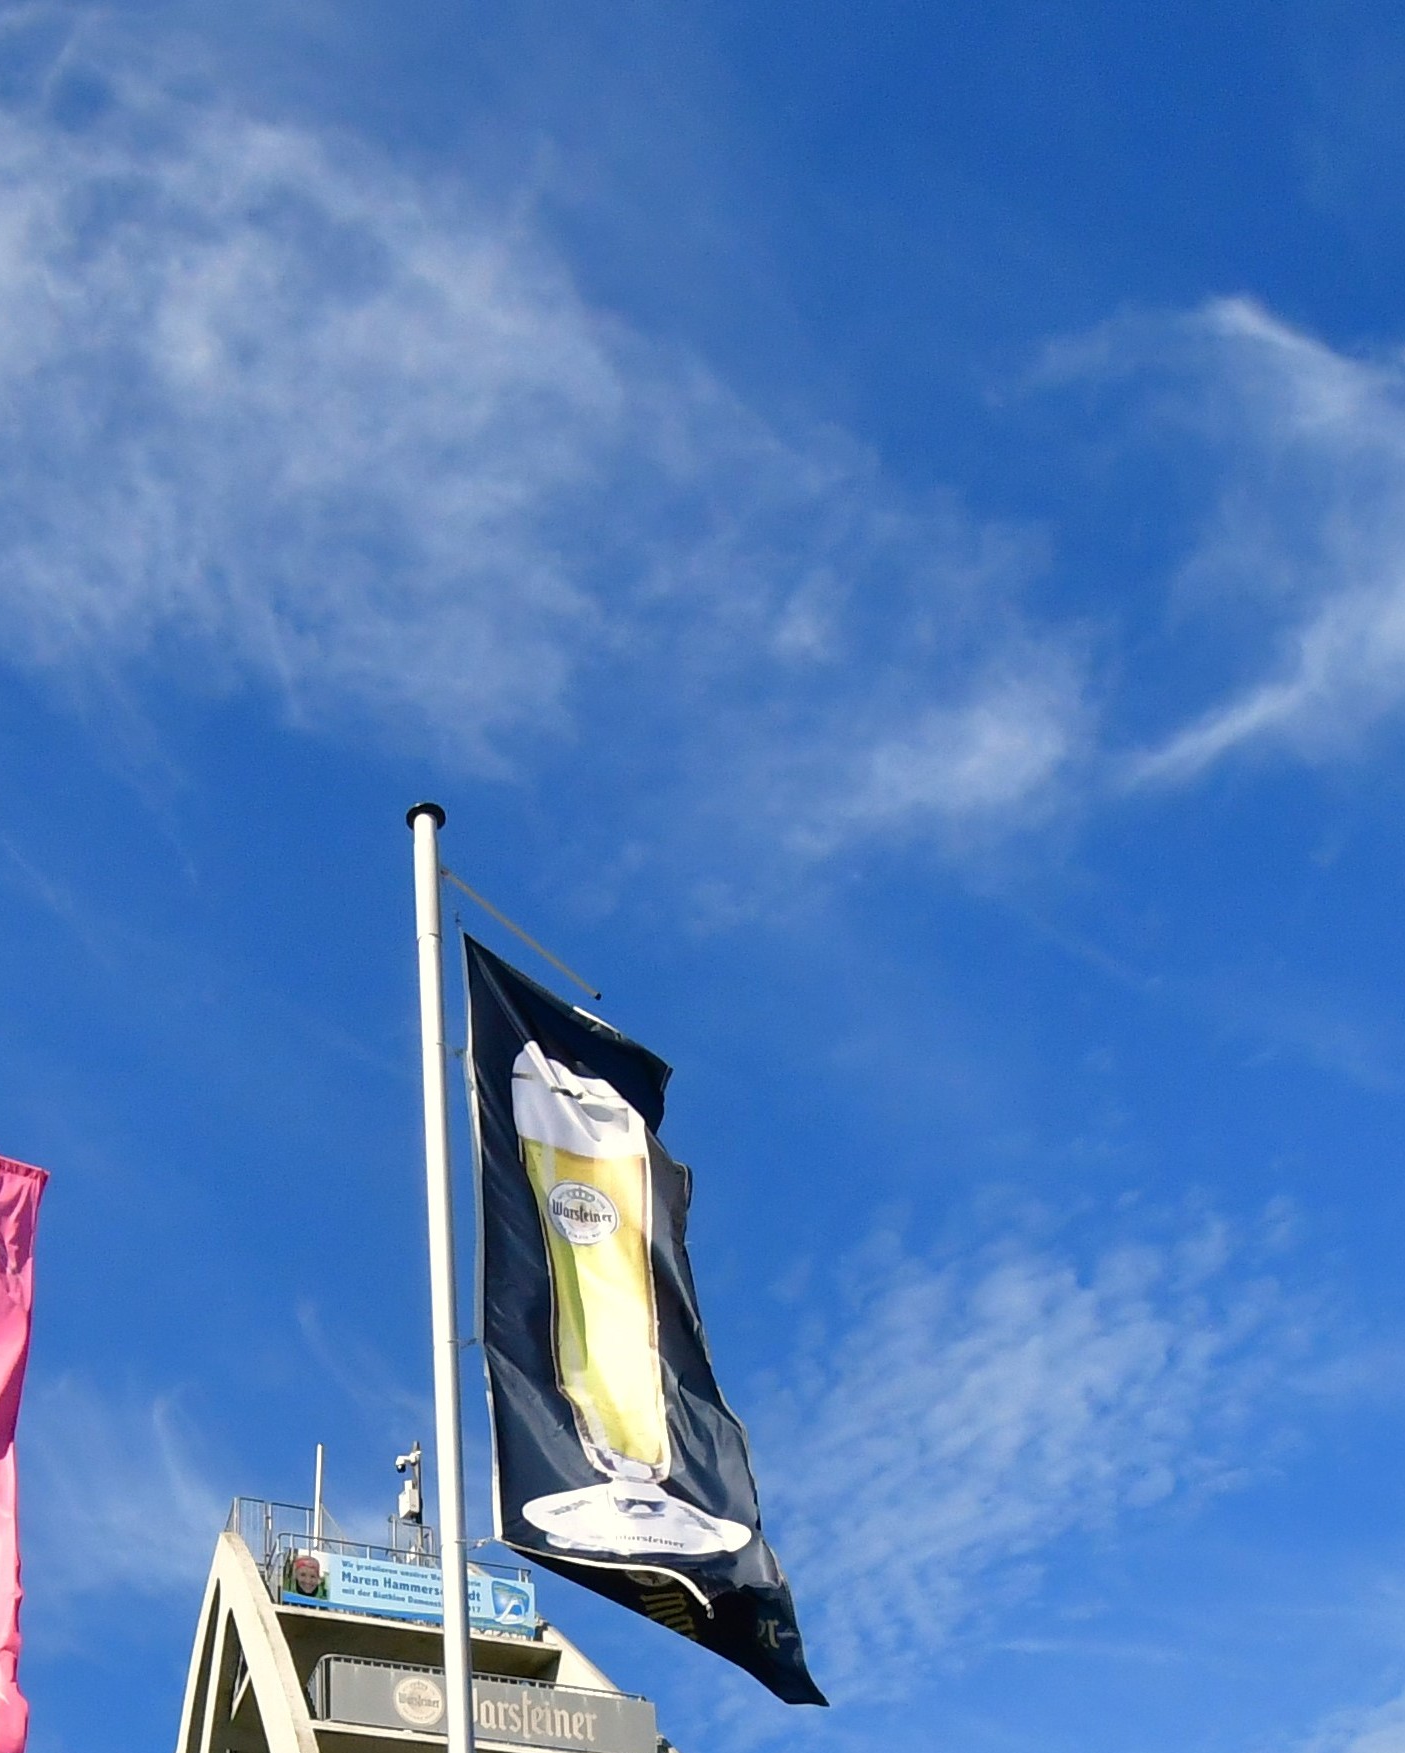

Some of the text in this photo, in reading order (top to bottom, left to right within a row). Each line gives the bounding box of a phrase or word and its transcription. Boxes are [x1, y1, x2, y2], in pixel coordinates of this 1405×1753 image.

[552, 1199, 612, 1223] Warsteiner
[341, 1571, 379, 1587] Maren
[341, 1588, 356, 1596] mit
[357, 1589, 371, 1598] der
[472, 1686, 598, 1742] arsteiner
